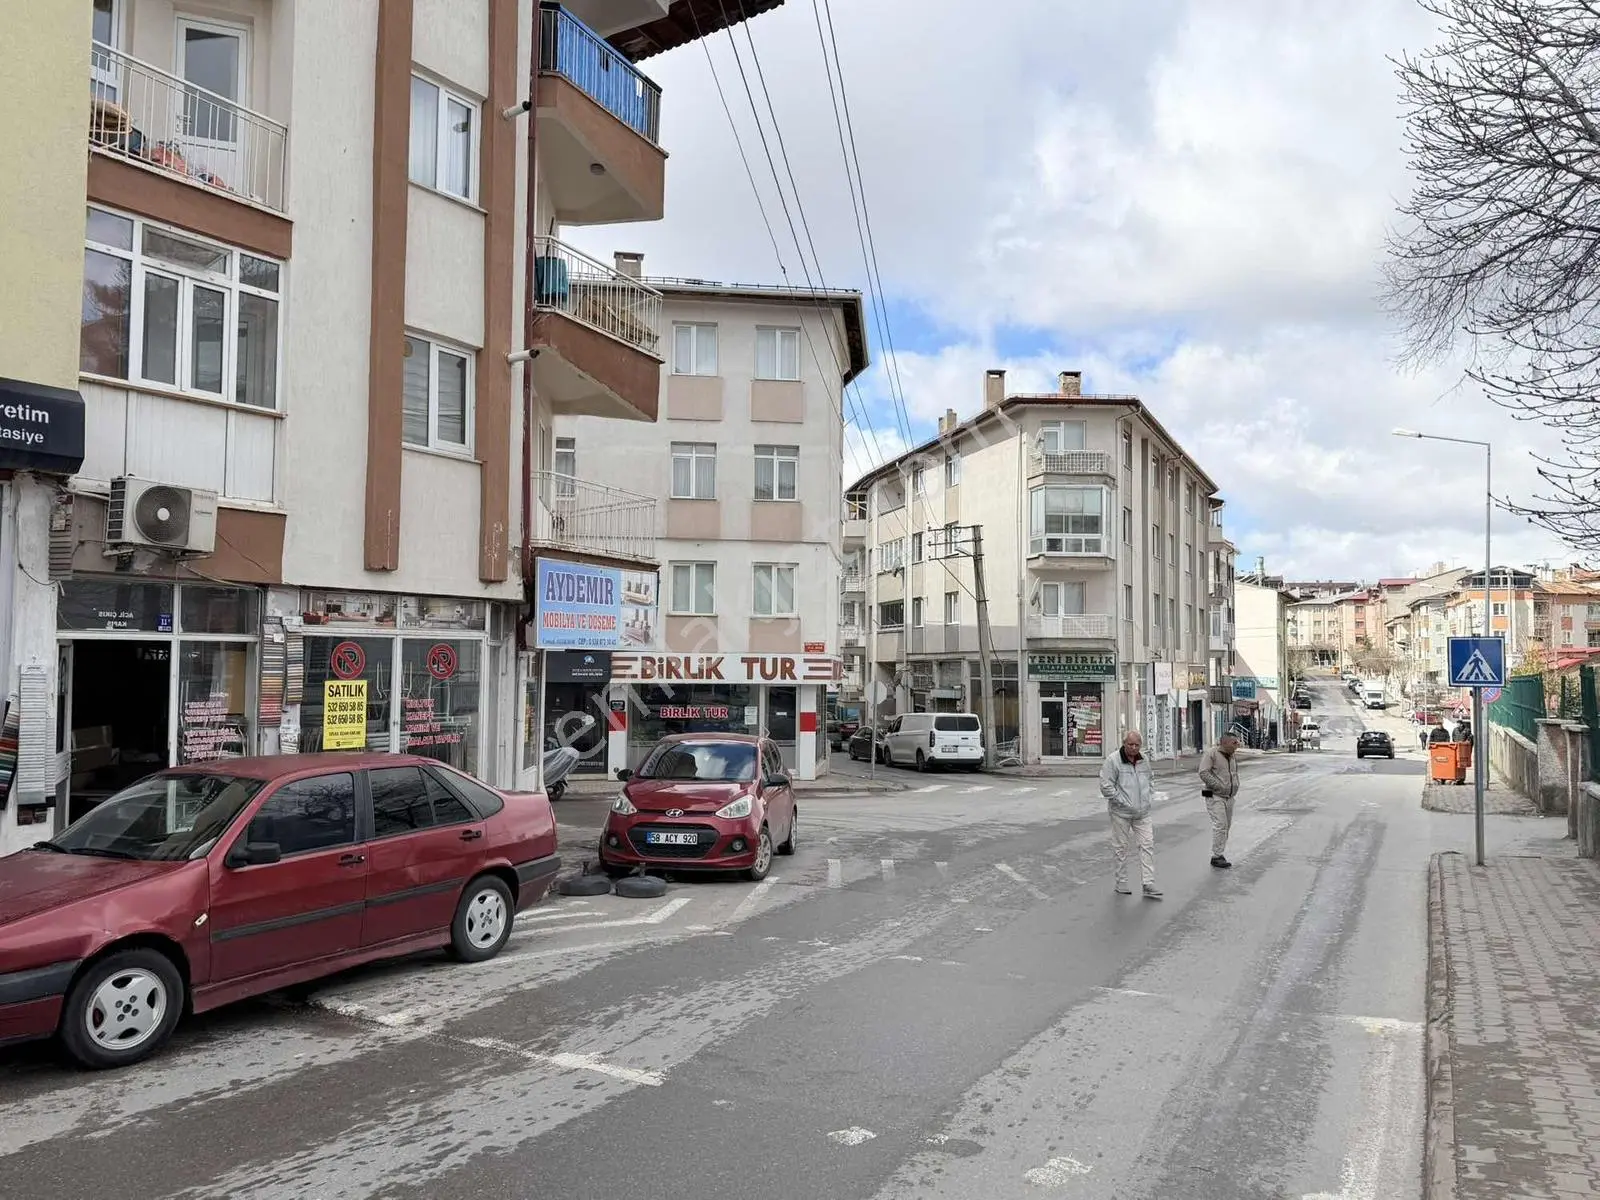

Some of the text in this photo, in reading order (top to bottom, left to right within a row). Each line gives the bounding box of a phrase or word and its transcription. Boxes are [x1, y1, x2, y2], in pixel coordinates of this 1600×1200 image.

[0, 426, 45, 445] asiye
[1029, 653, 1113, 664] YENİ BİRLİK
[741, 656, 798, 681] TUR
[328, 684, 364, 698] SATILIK
[327, 701, 338, 712] 532
[357, 701, 364, 711] 85
[660, 704, 729, 719] BİRLİK TUR
[327, 714, 338, 725] 532
[357, 713, 364, 724] 85
[651, 832, 697, 844] 58 ACY 920
